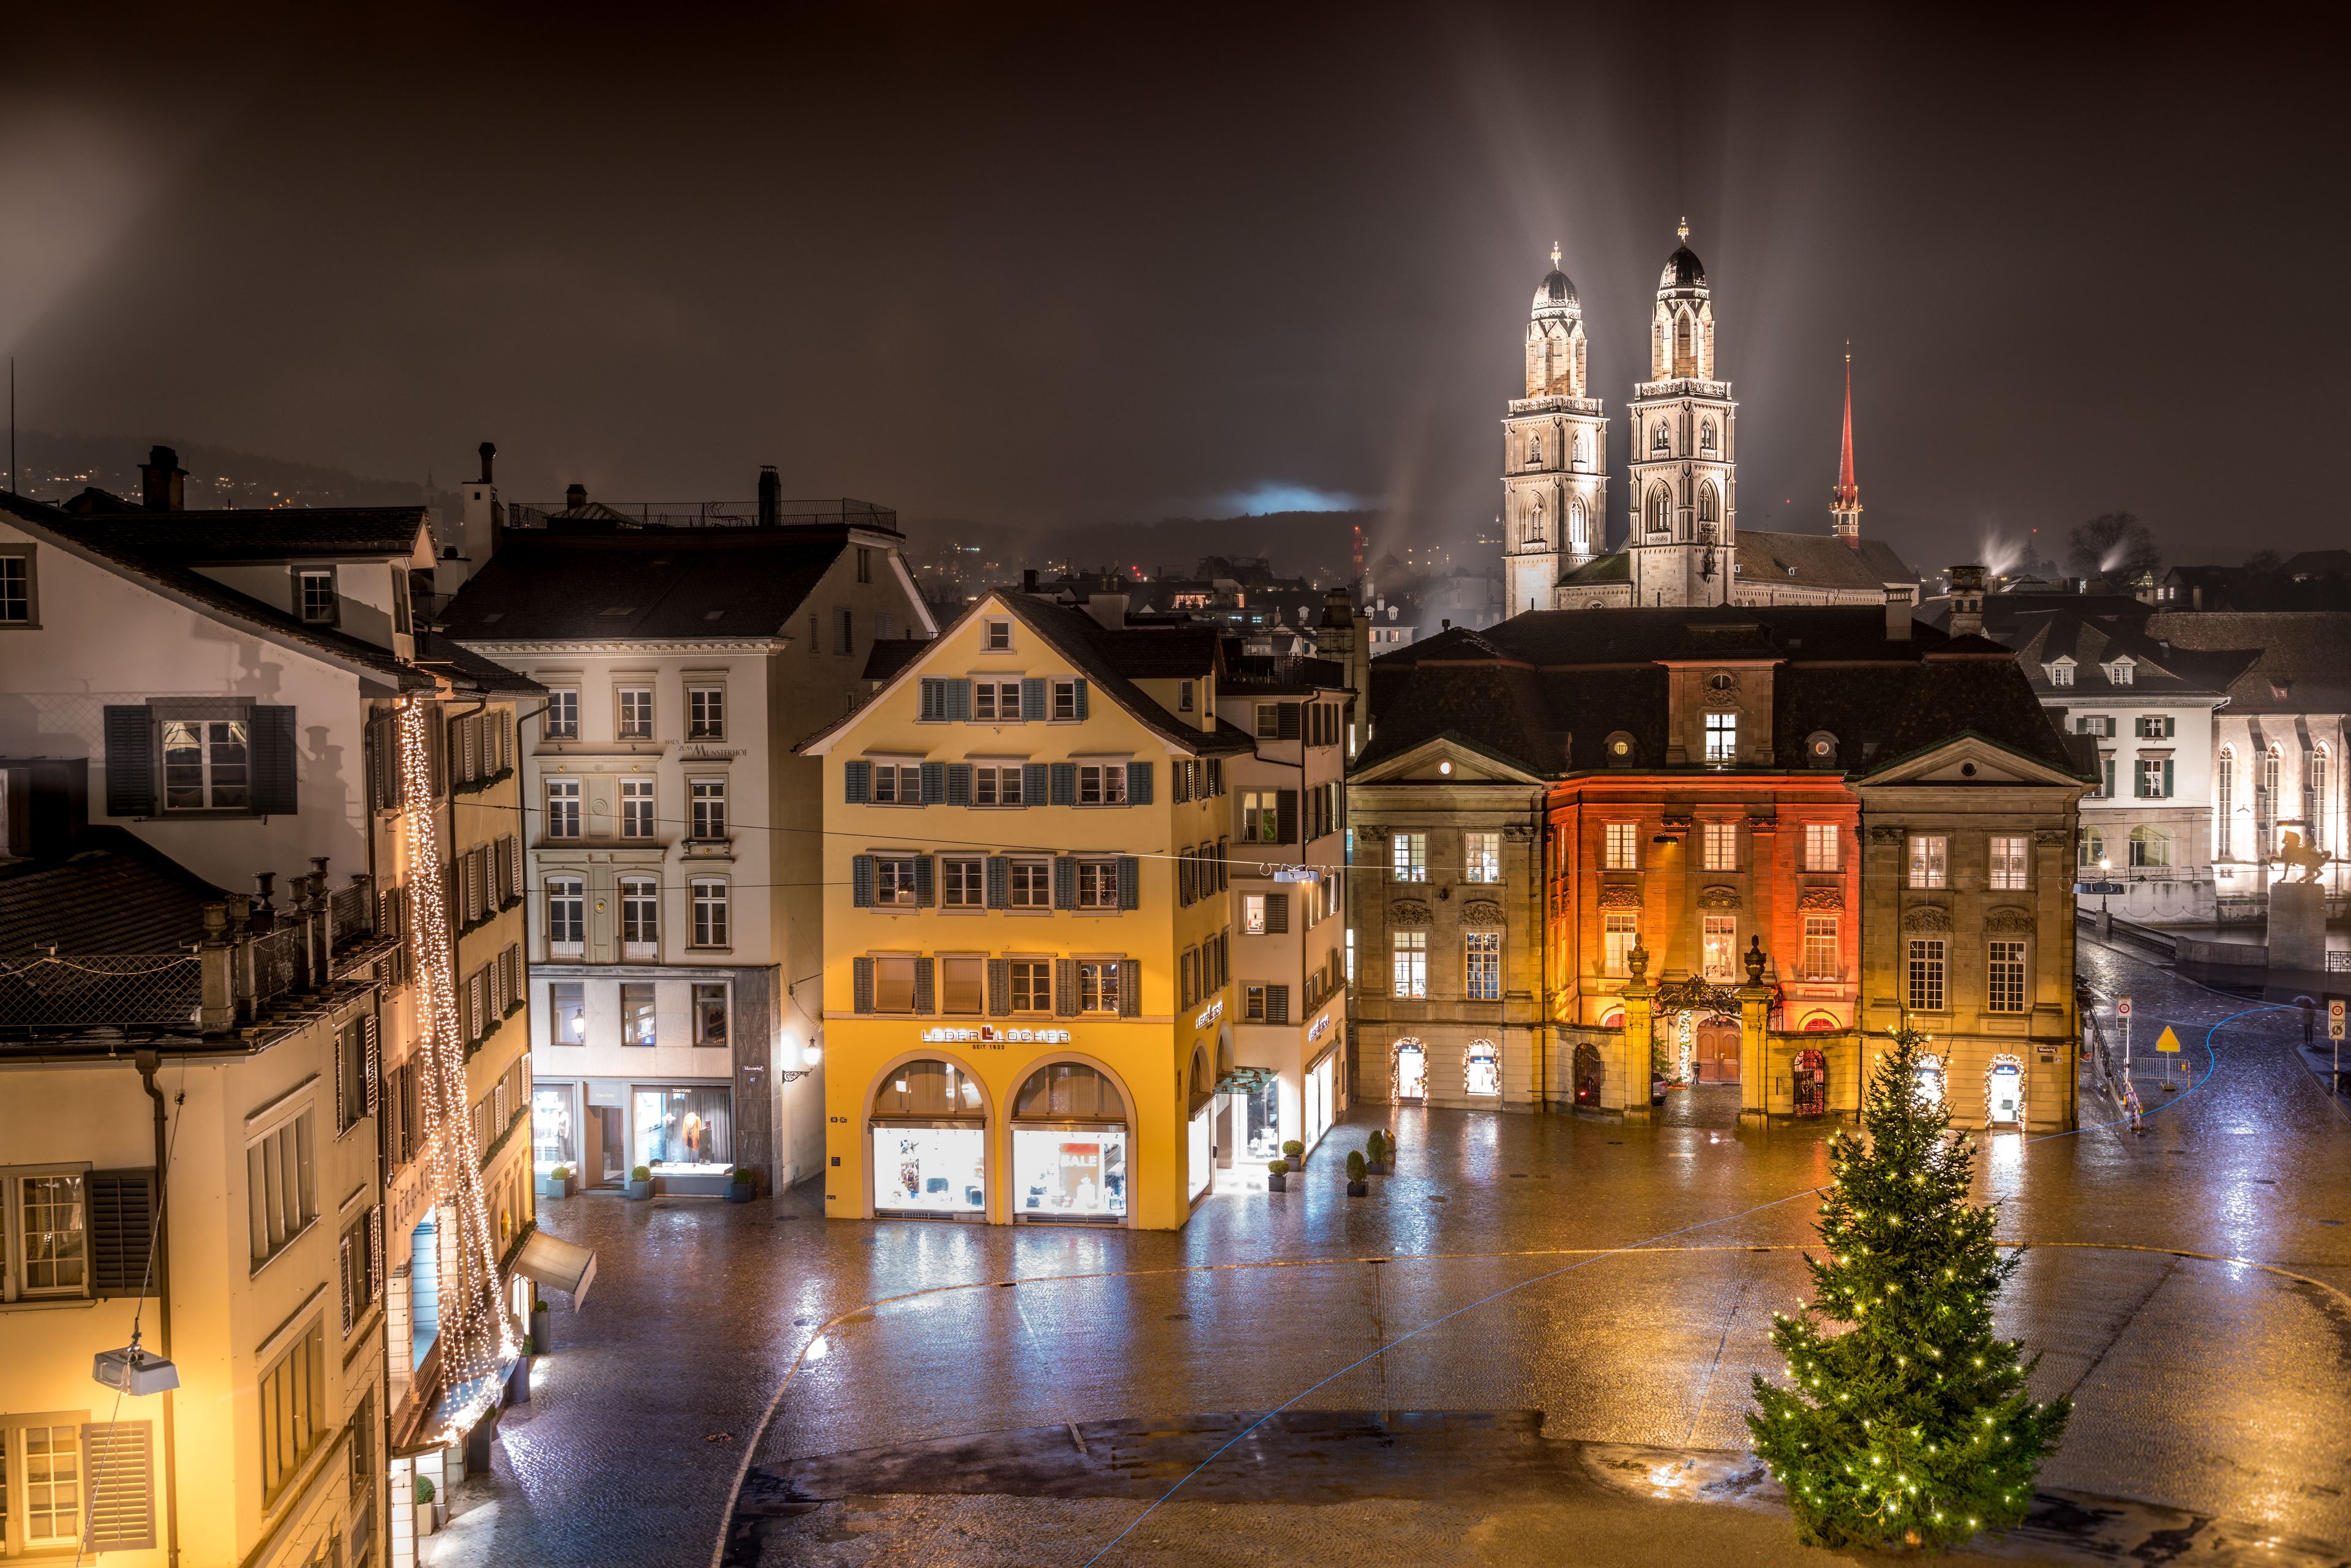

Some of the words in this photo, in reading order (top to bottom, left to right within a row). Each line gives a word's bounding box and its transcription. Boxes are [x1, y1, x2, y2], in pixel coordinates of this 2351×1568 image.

[923, 1030, 979, 1041] LEDER
[997, 1032, 1069, 1041] LOCHER
[1060, 1155, 1097, 1166] SALE
